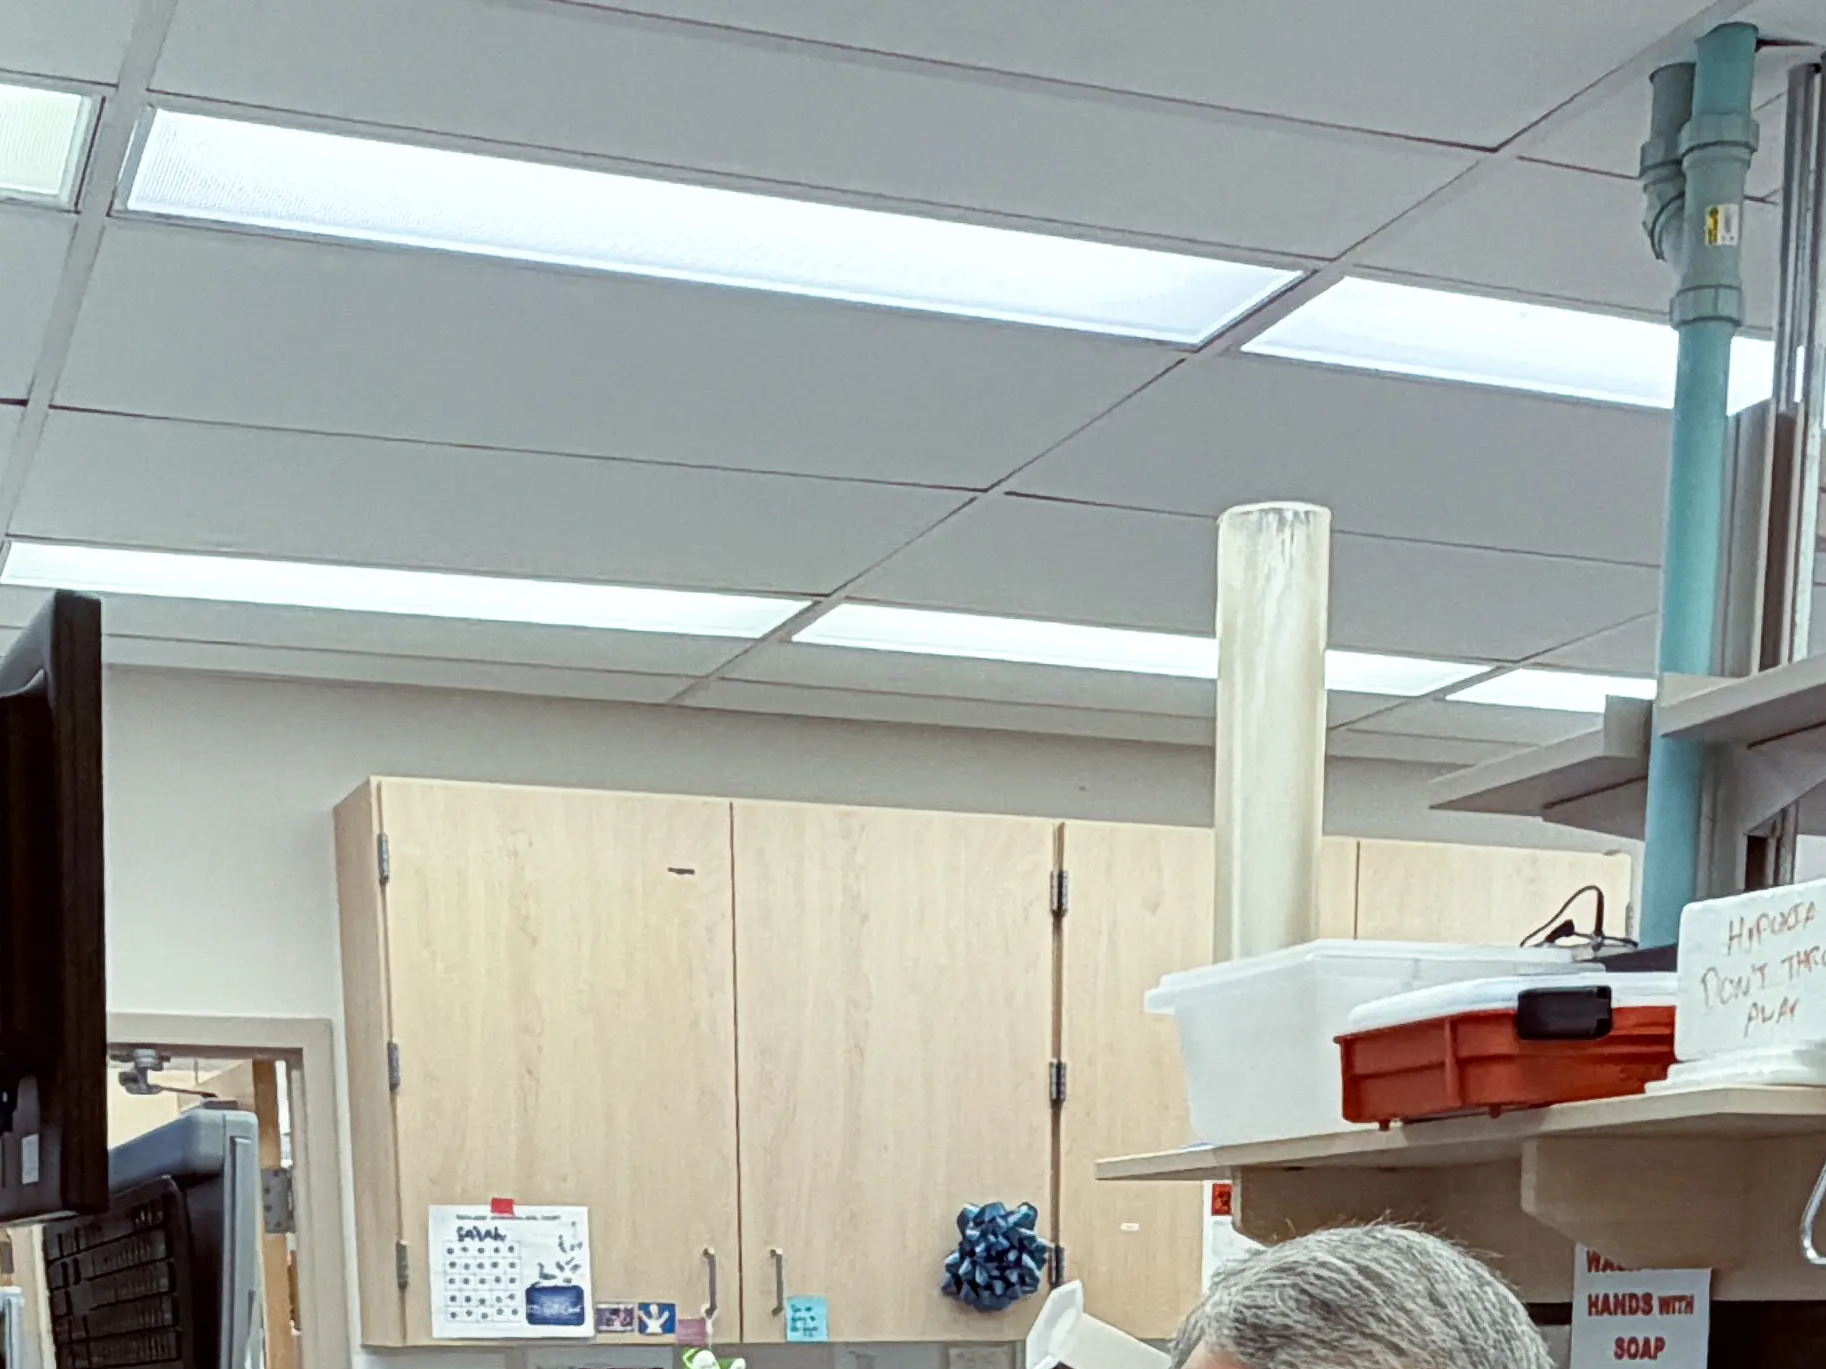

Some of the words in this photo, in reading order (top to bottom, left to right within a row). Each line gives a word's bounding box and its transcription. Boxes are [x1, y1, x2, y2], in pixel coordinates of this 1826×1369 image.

[1587, 1292, 1654, 1317] HANDS
[1658, 1293, 1695, 1316] WITH
[1614, 1336, 1666, 1361] SOAP
